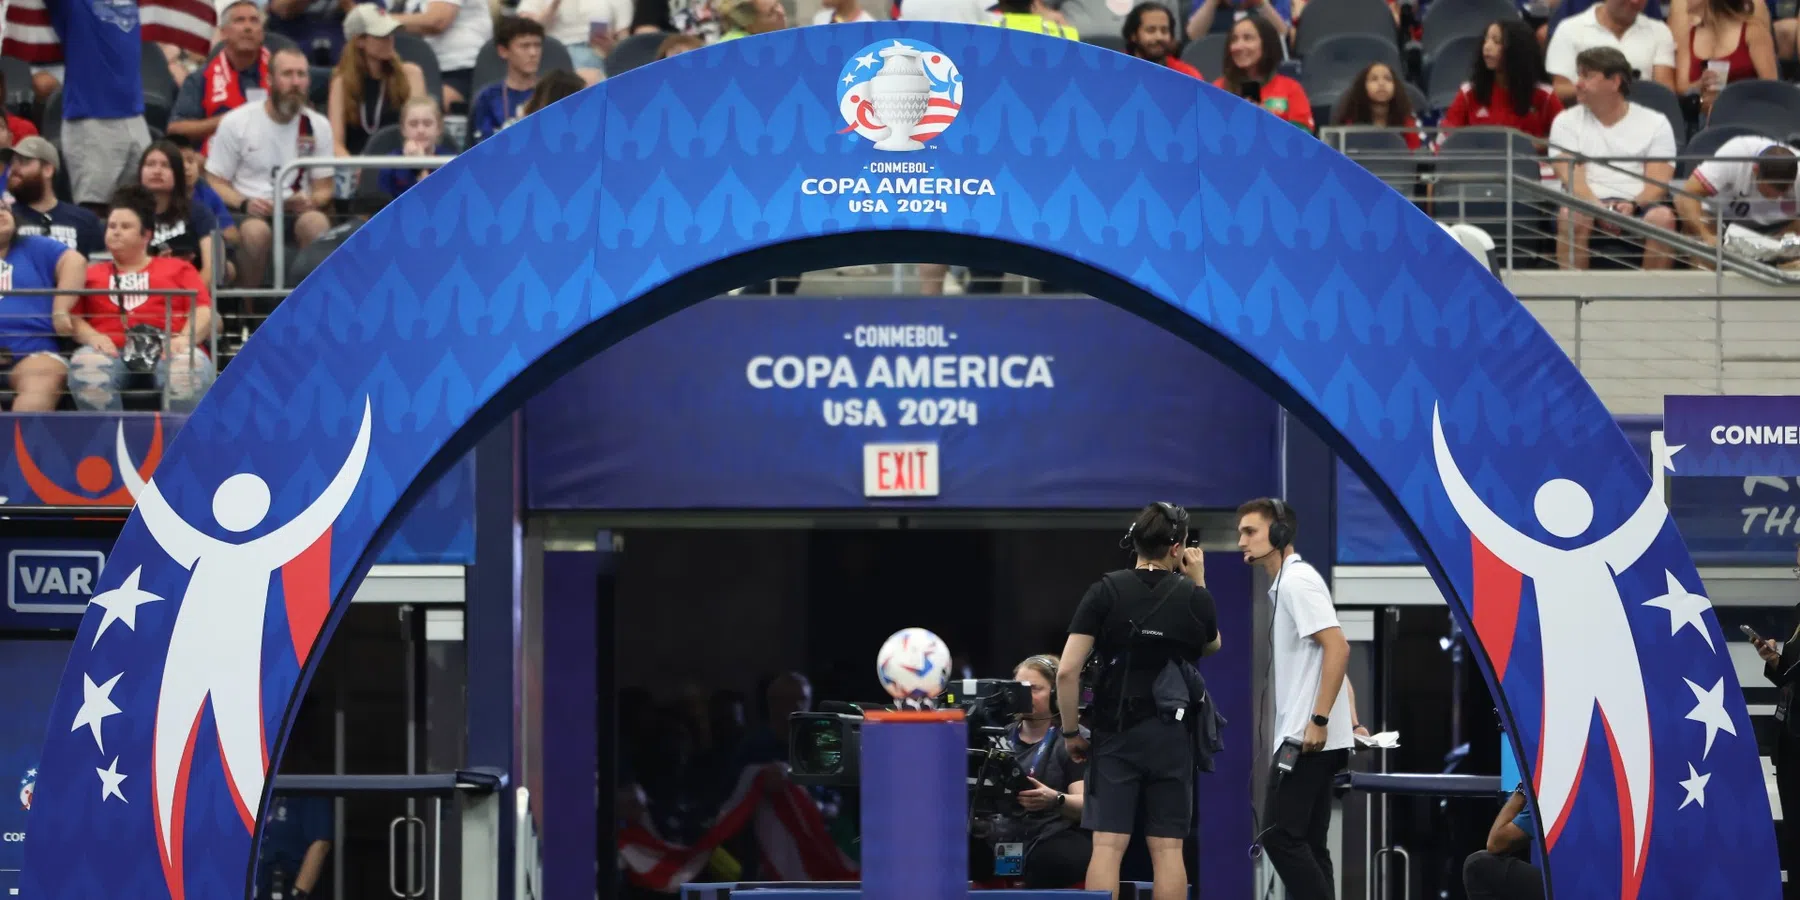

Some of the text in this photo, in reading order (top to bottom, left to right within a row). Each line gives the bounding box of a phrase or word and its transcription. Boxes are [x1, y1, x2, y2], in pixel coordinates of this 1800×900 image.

[801, 178, 996, 196] COPA AMERICA
[849, 200, 948, 214] USA 2024
[747, 356, 1054, 389] COPA AMERICA
[823, 398, 978, 427] USA 2024
[1711, 425, 1800, 445] CONME
[877, 451, 929, 490] EXIT
[19, 566, 93, 595] VAR
